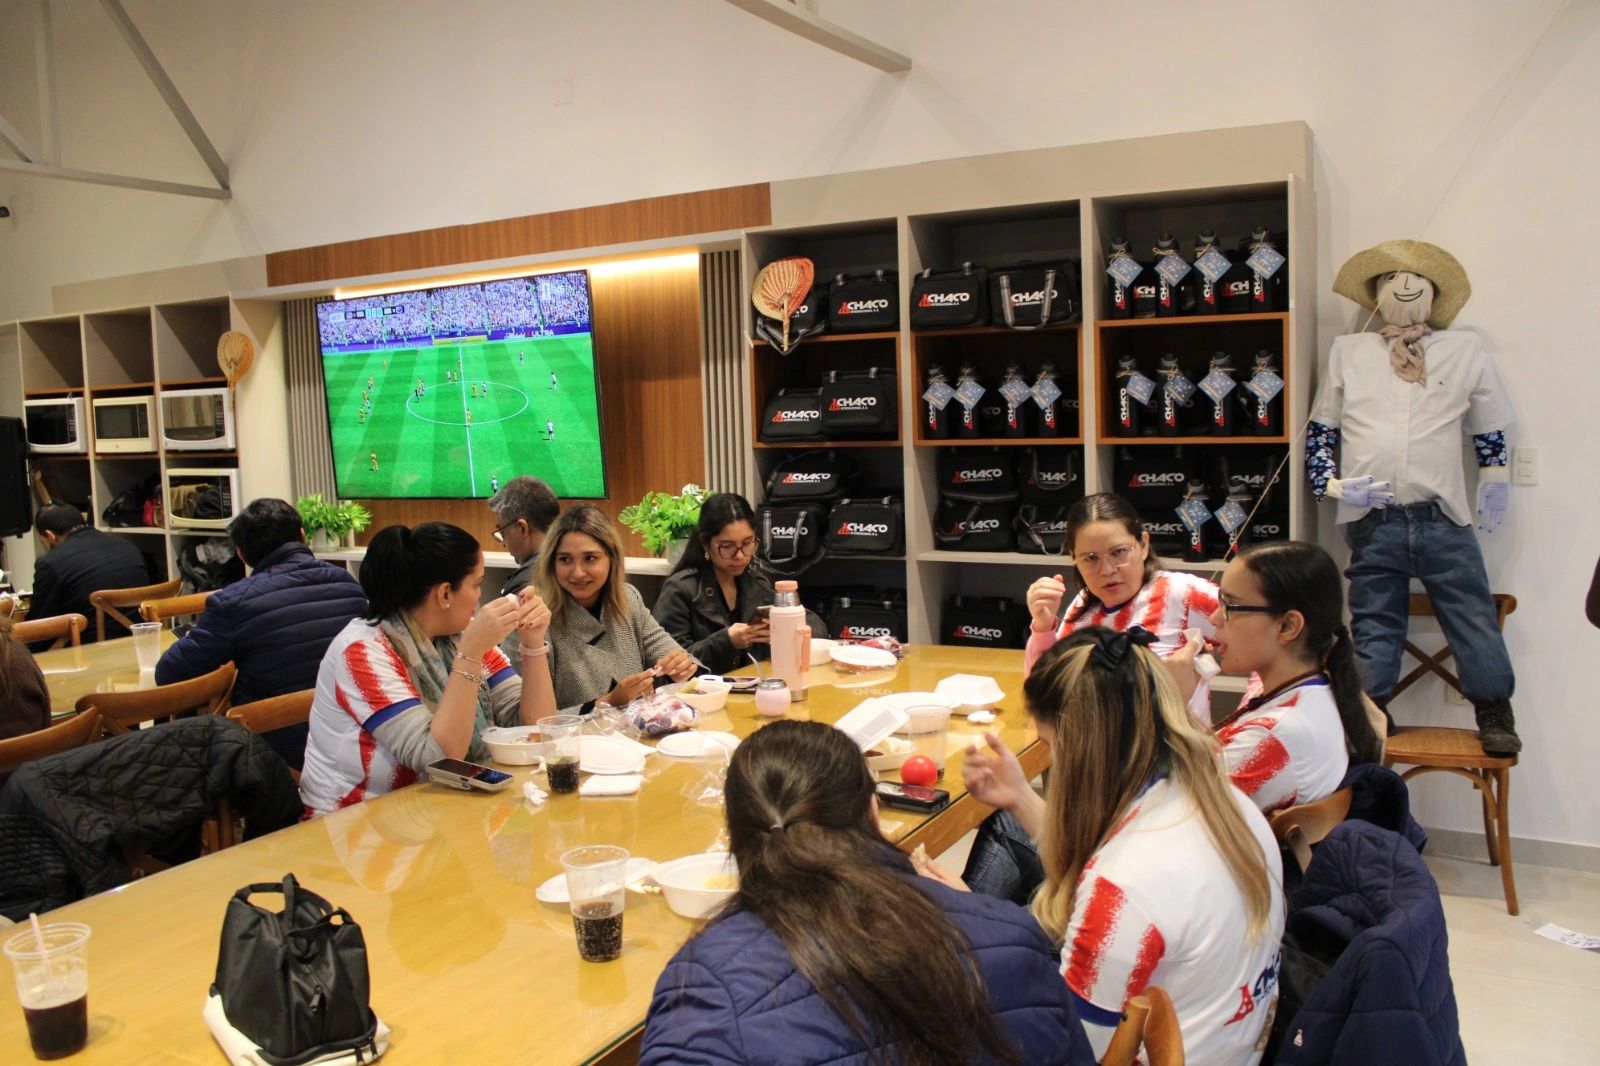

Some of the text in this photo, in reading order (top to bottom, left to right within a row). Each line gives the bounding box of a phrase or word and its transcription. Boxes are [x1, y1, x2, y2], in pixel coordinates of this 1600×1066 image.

[927, 292, 970, 303] CHACO
[847, 299, 889, 310] CHACO
[837, 396, 877, 407] CHACO
[781, 410, 820, 420] CHACO
[792, 472, 831, 481] CHACO
[960, 468, 1003, 479] CHACO
[1138, 472, 1185, 482] CHACO
[847, 522, 888, 533] CHACO
[848, 626, 891, 637] CHACO
[962, 625, 1003, 638] CHACO
